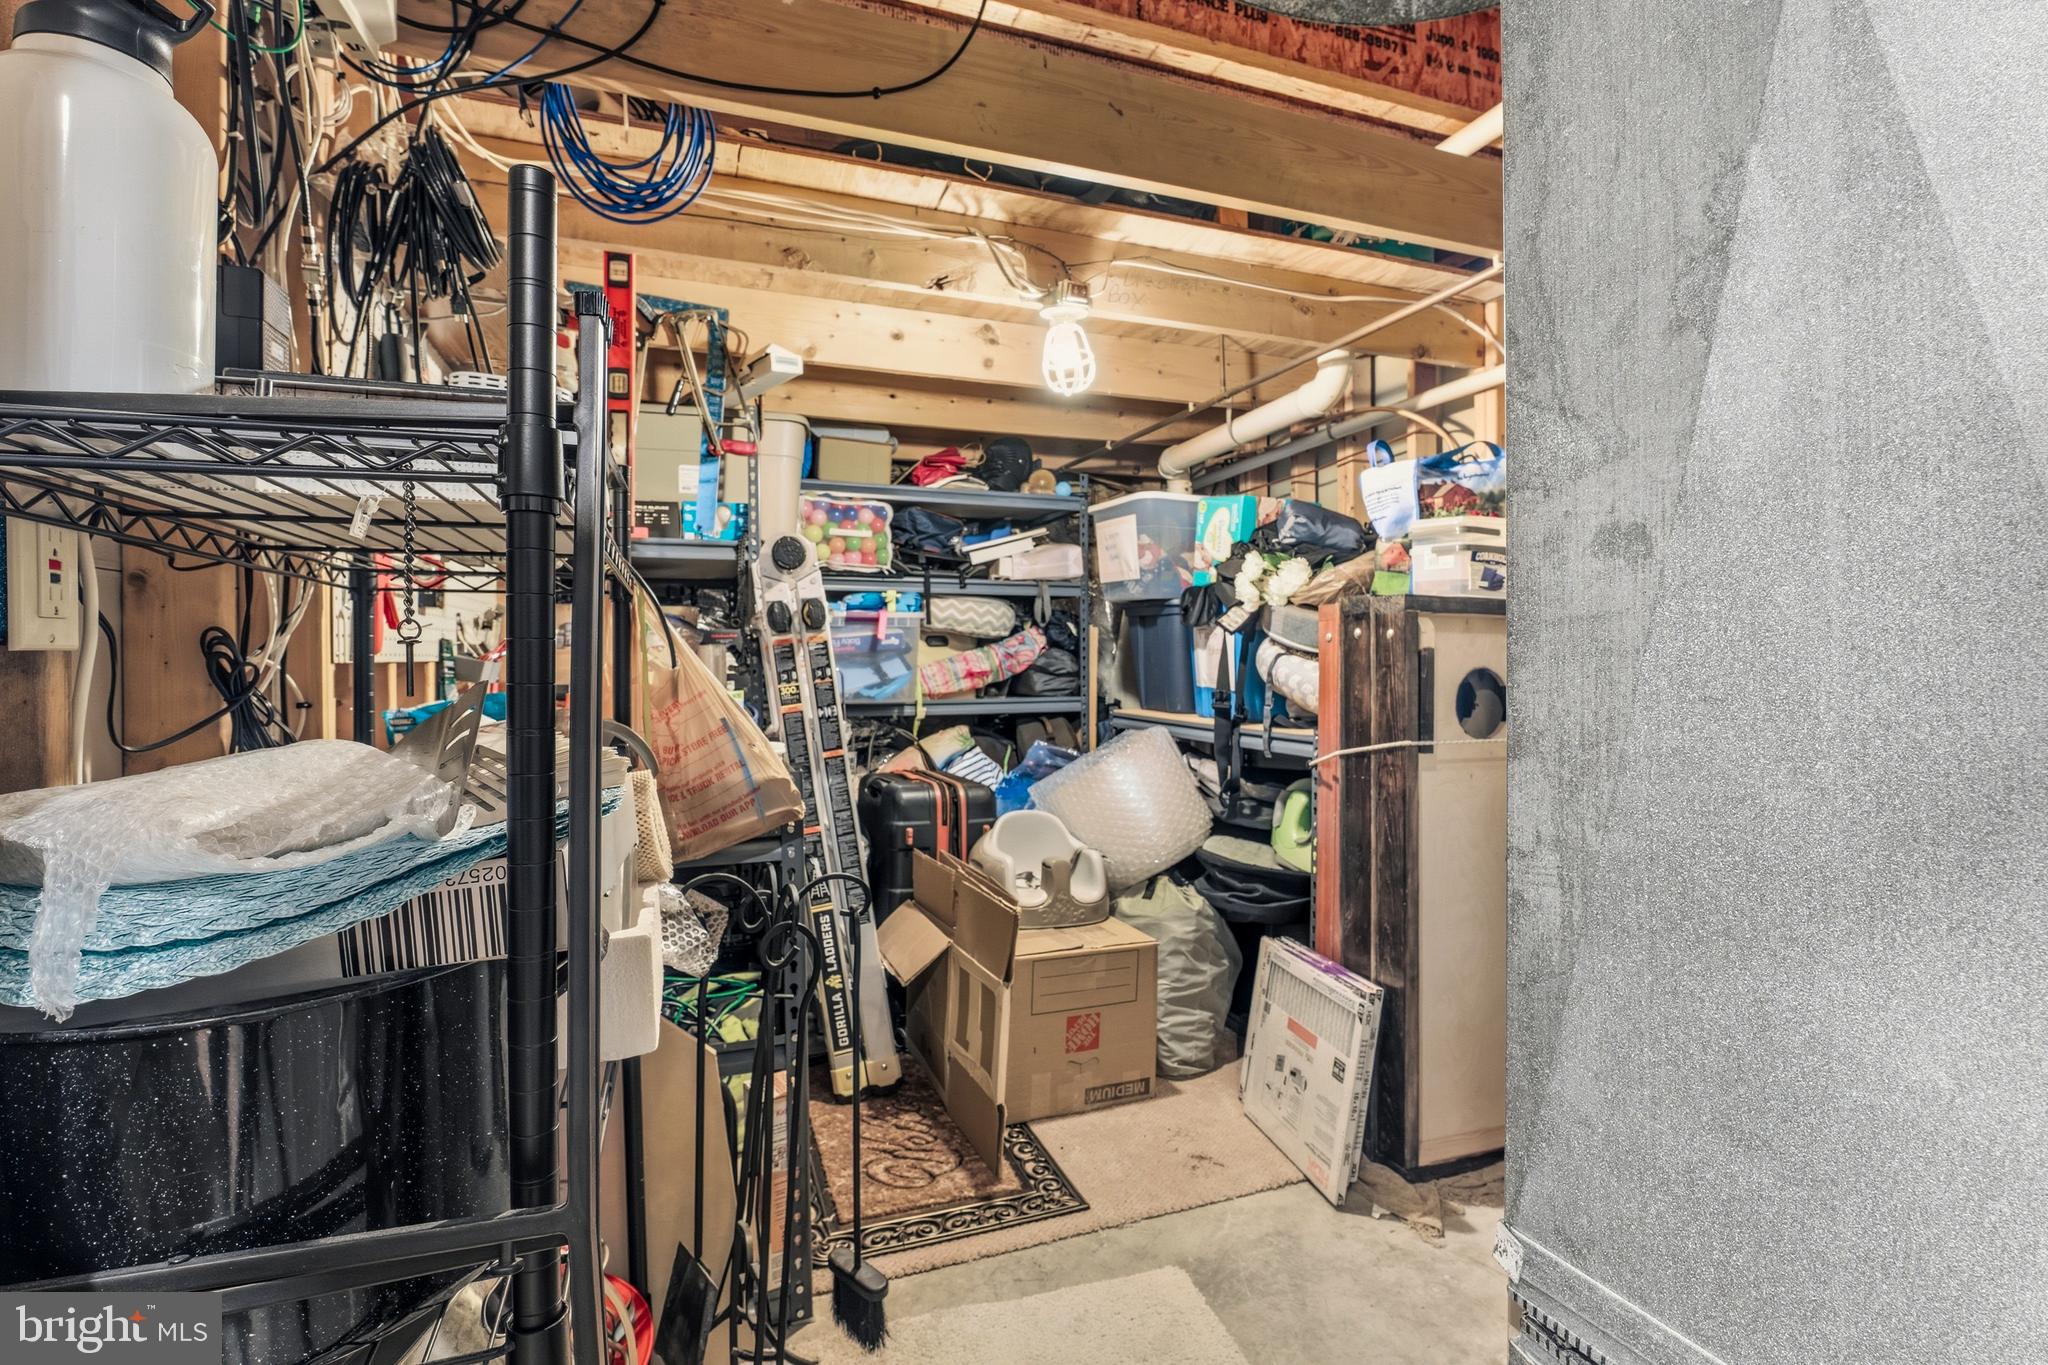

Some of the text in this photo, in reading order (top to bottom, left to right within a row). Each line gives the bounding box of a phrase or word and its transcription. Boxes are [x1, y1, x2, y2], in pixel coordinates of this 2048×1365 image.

[780, 685, 797, 695] 300
[686, 777, 715, 798] TRUCK
[739, 797, 756, 812] APP
[819, 913, 838, 972] LADDERS
[831, 992, 850, 1047] GORILLA
[1088, 1081, 1146, 1103] MEDIUM
